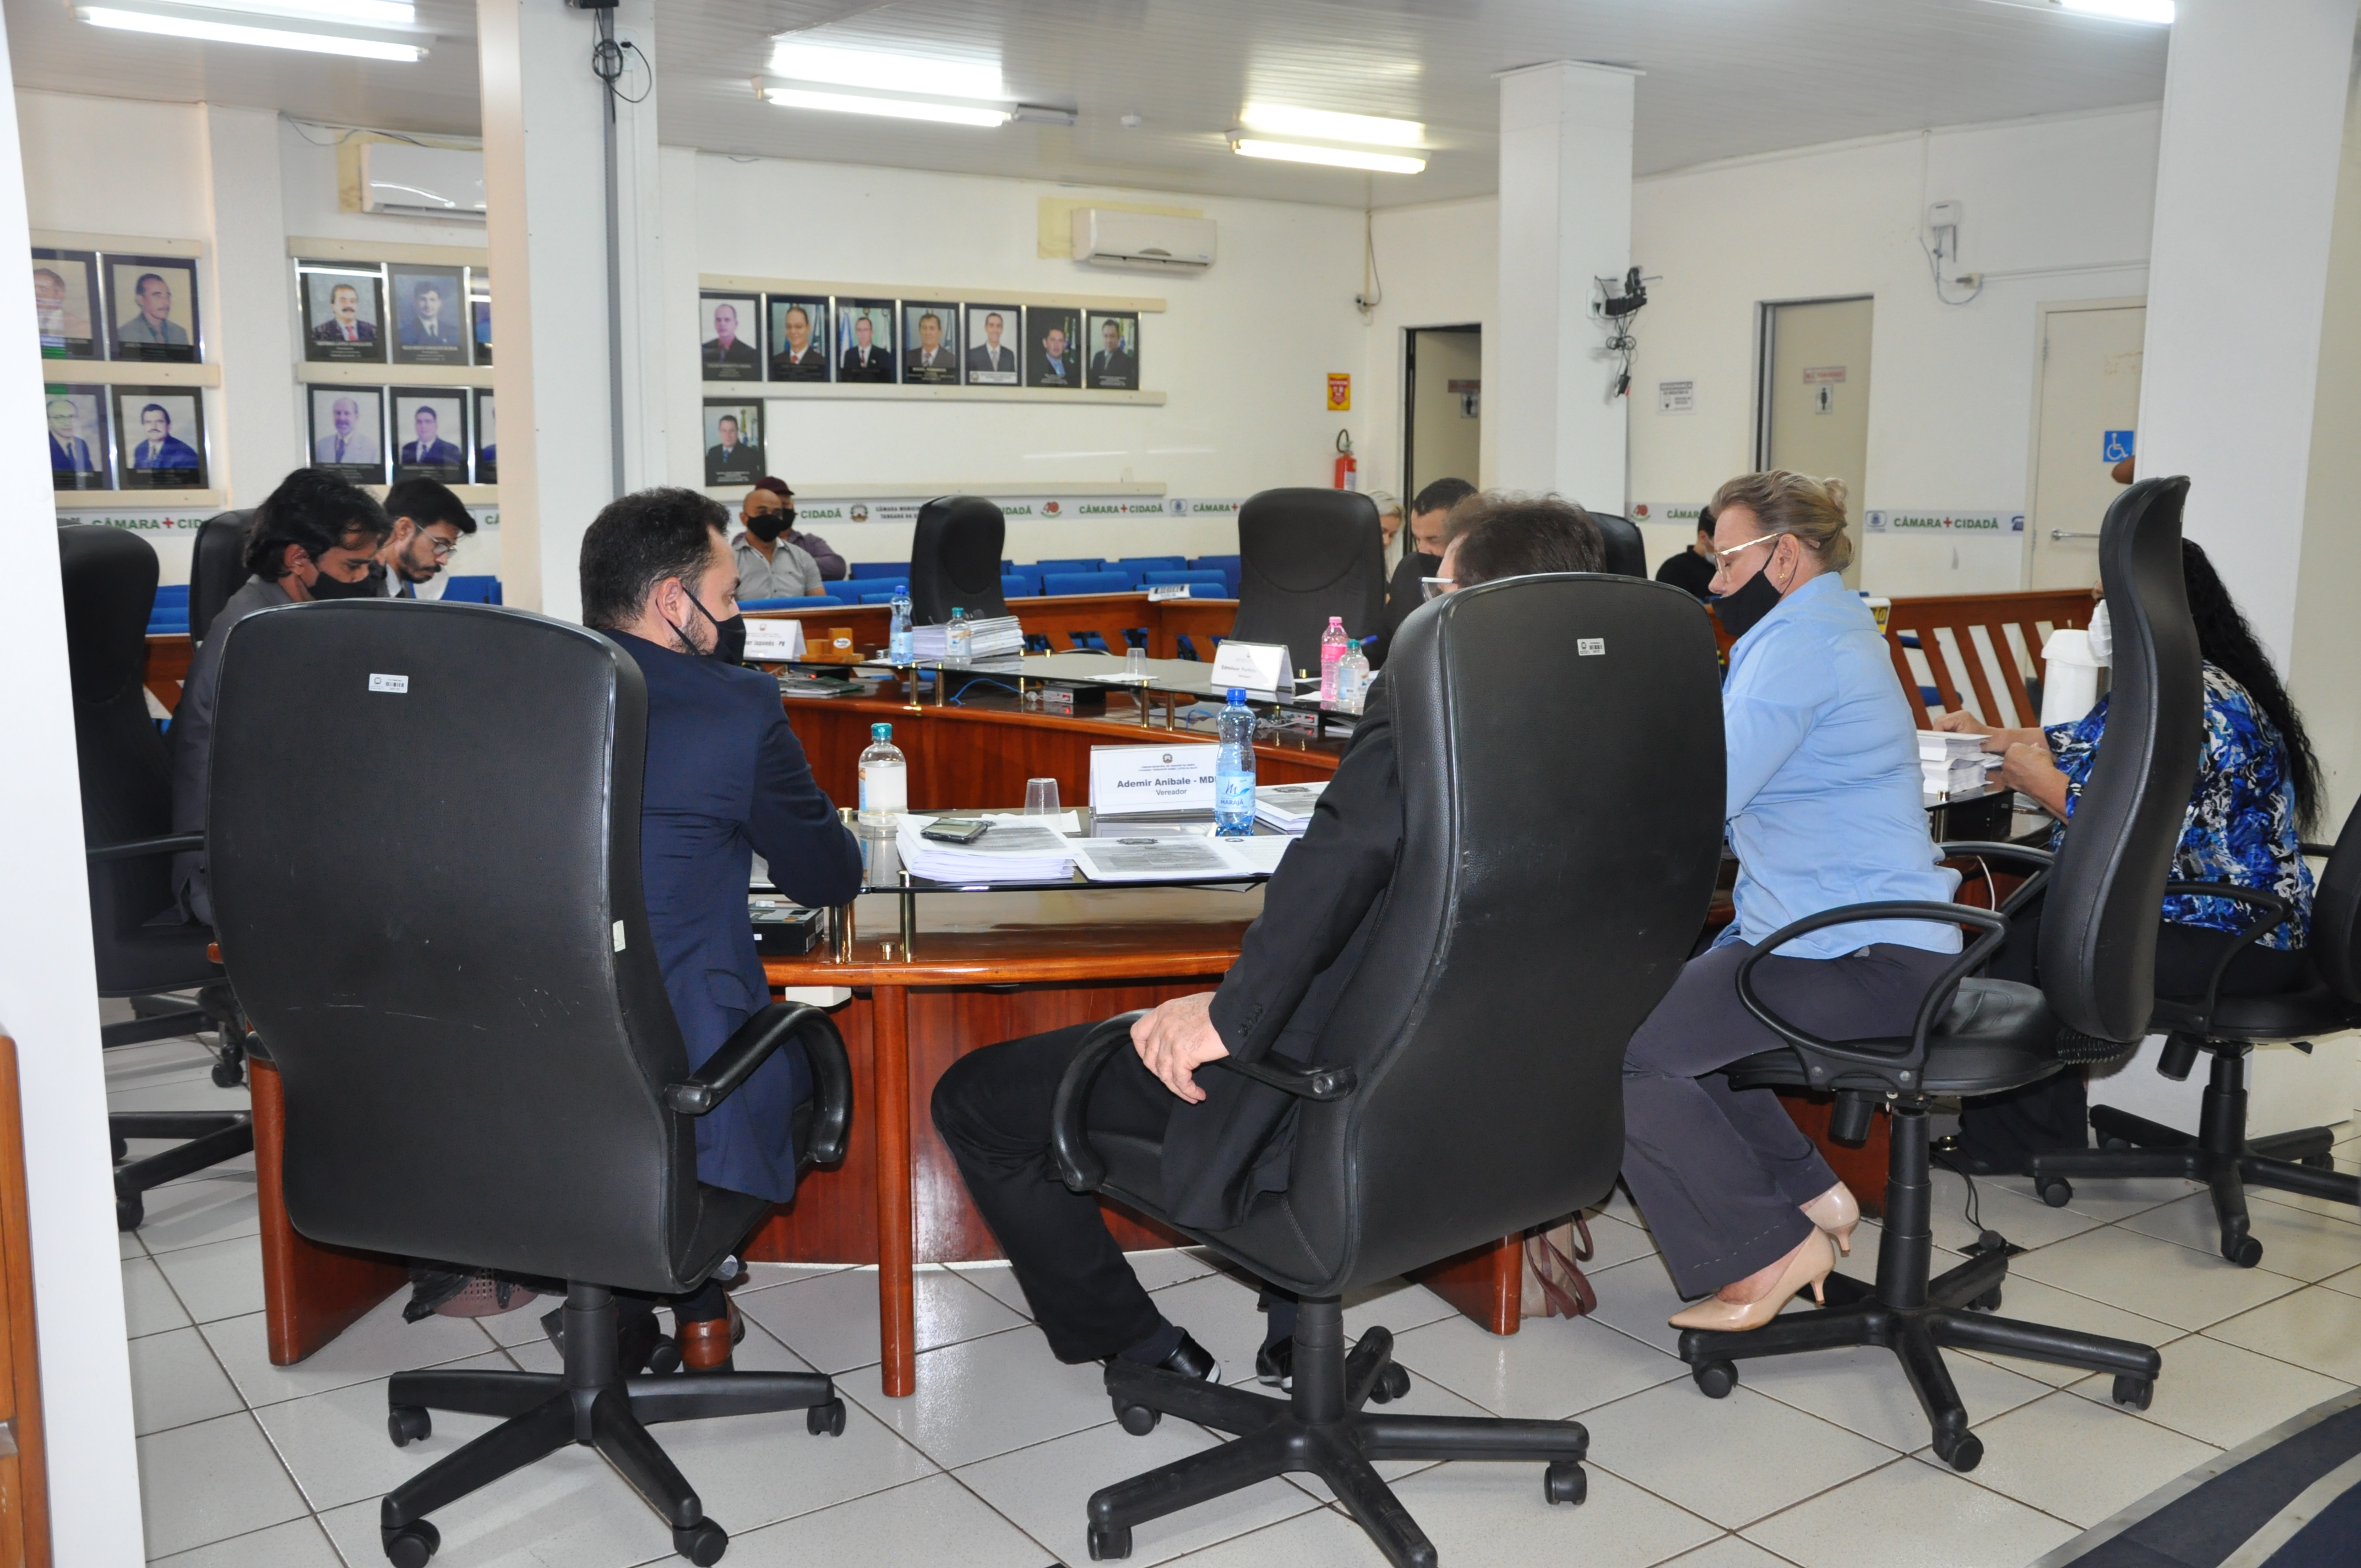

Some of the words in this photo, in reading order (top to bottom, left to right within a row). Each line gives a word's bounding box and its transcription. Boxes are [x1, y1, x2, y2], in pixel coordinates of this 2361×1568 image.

[1002, 505, 1032, 515] IDADÃ
[1079, 504, 1119, 514] CÂMARA
[1129, 503, 1163, 513] CIDADÃ
[1193, 503, 1230, 512] CÂMARA
[801, 508, 841, 519] CIDADÃ
[1667, 508, 1700, 519] CÂMAR
[1894, 515, 1941, 527] CÂMARA
[1955, 518, 1999, 529] CIDADÃ
[1117, 779, 1151, 788] Ademir
[1154, 777, 1191, 786] Anibale
[1199, 775, 1216, 784] MD
